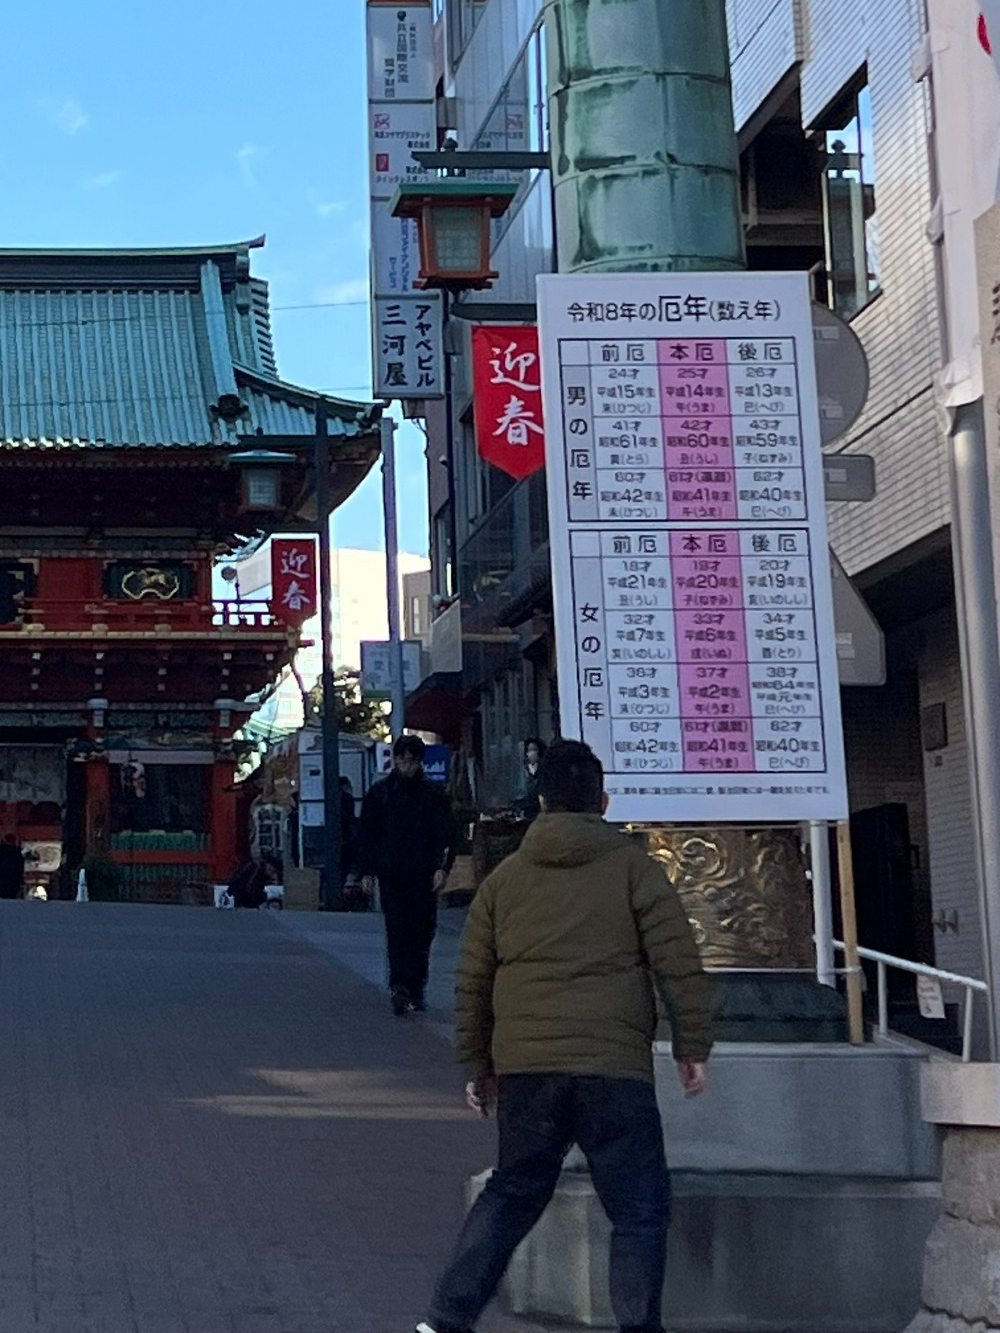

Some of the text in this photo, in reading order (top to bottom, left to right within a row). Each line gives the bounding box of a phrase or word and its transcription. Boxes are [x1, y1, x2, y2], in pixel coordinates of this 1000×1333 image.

[567, 294, 781, 322] 令和8年の厄年(数え年)
[381, 304, 409, 387] 三河屋
[415, 303, 435, 388] アヤベビル
[602, 343, 782, 361] 前厄 本厄 後厄
[490, 341, 544, 447] 迎春
[597, 384, 793, 398] 平成15年生 平成14年生 平成13年生
[567, 387, 592, 499] 男の厄年
[613, 534, 797, 553] 前厄 本厄 後厄
[280, 547, 310, 611] 迎春
[580, 603, 605, 721] 女の厄年
[616, 629, 665, 642] 平成7年生
